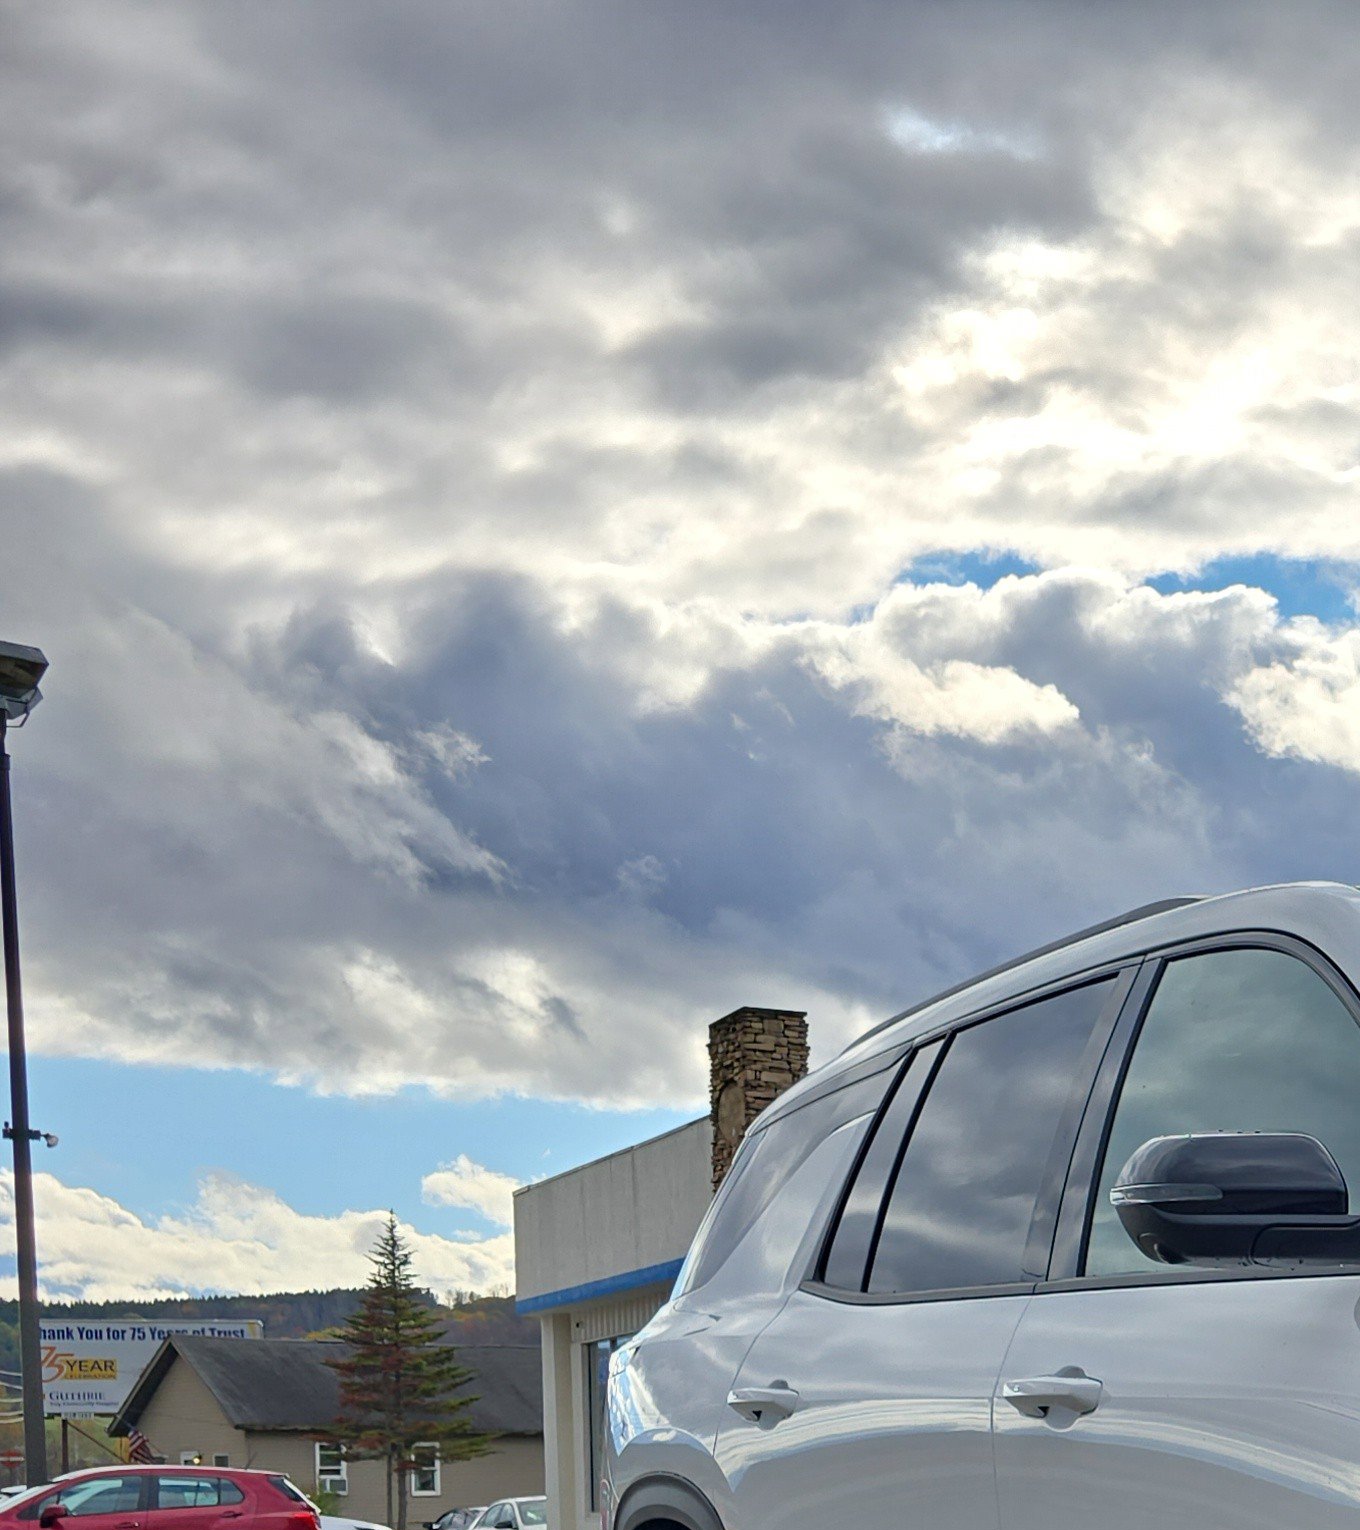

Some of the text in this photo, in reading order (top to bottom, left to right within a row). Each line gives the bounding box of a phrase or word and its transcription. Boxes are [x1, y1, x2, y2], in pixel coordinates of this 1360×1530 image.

[41, 1327, 74, 1340] hank
[77, 1327, 102, 1340] You
[106, 1327, 126, 1340] for
[130, 1327, 146, 1340] 75
[209, 1327, 245, 1338] Trust
[66, 1360, 115, 1372] YEAR
